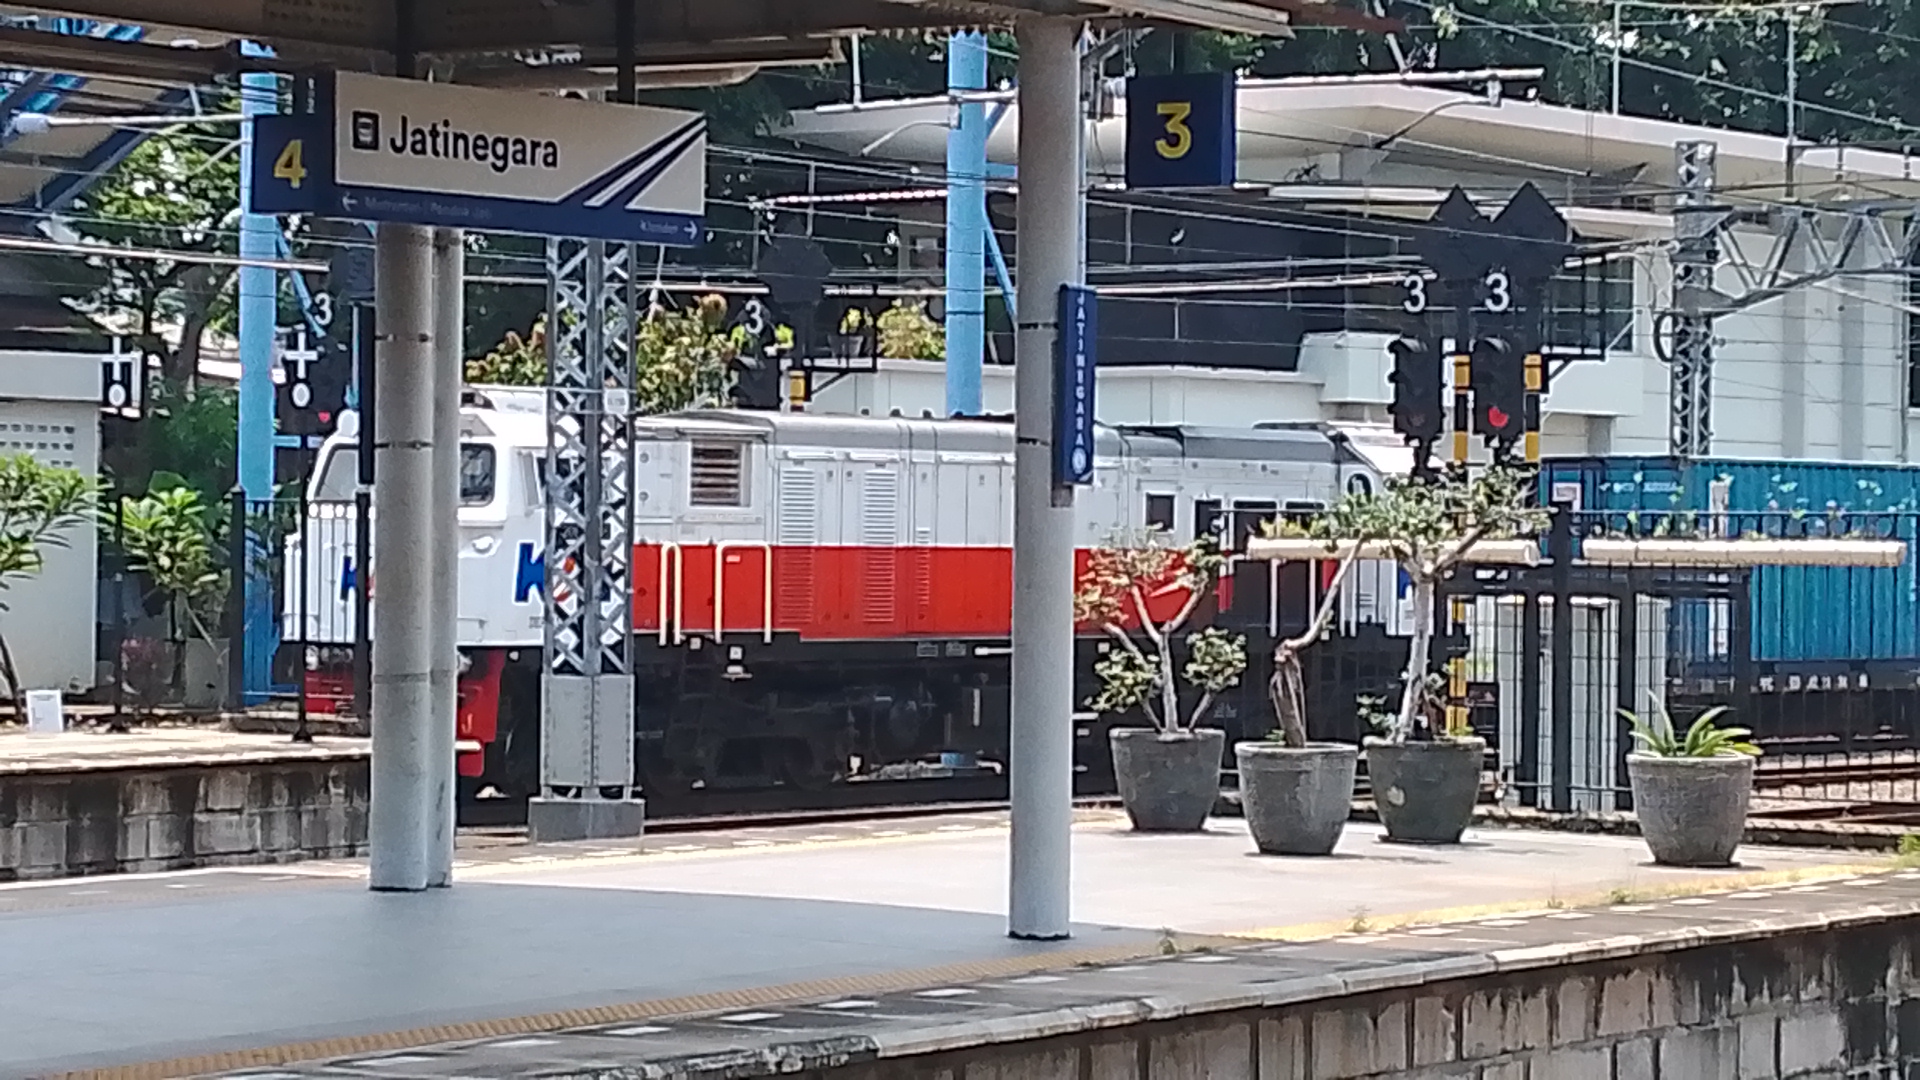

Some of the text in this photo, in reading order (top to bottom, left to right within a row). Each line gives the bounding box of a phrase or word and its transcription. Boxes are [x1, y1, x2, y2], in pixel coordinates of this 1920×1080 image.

[389, 115, 559, 173] Jatinegara
[1155, 102, 1192, 158] 3
[274, 139, 307, 189] 4
[314, 292, 333, 326] 3
[1403, 275, 1426, 313] 3
[1484, 273, 1511, 312] 3
[744, 300, 764, 335] 3
